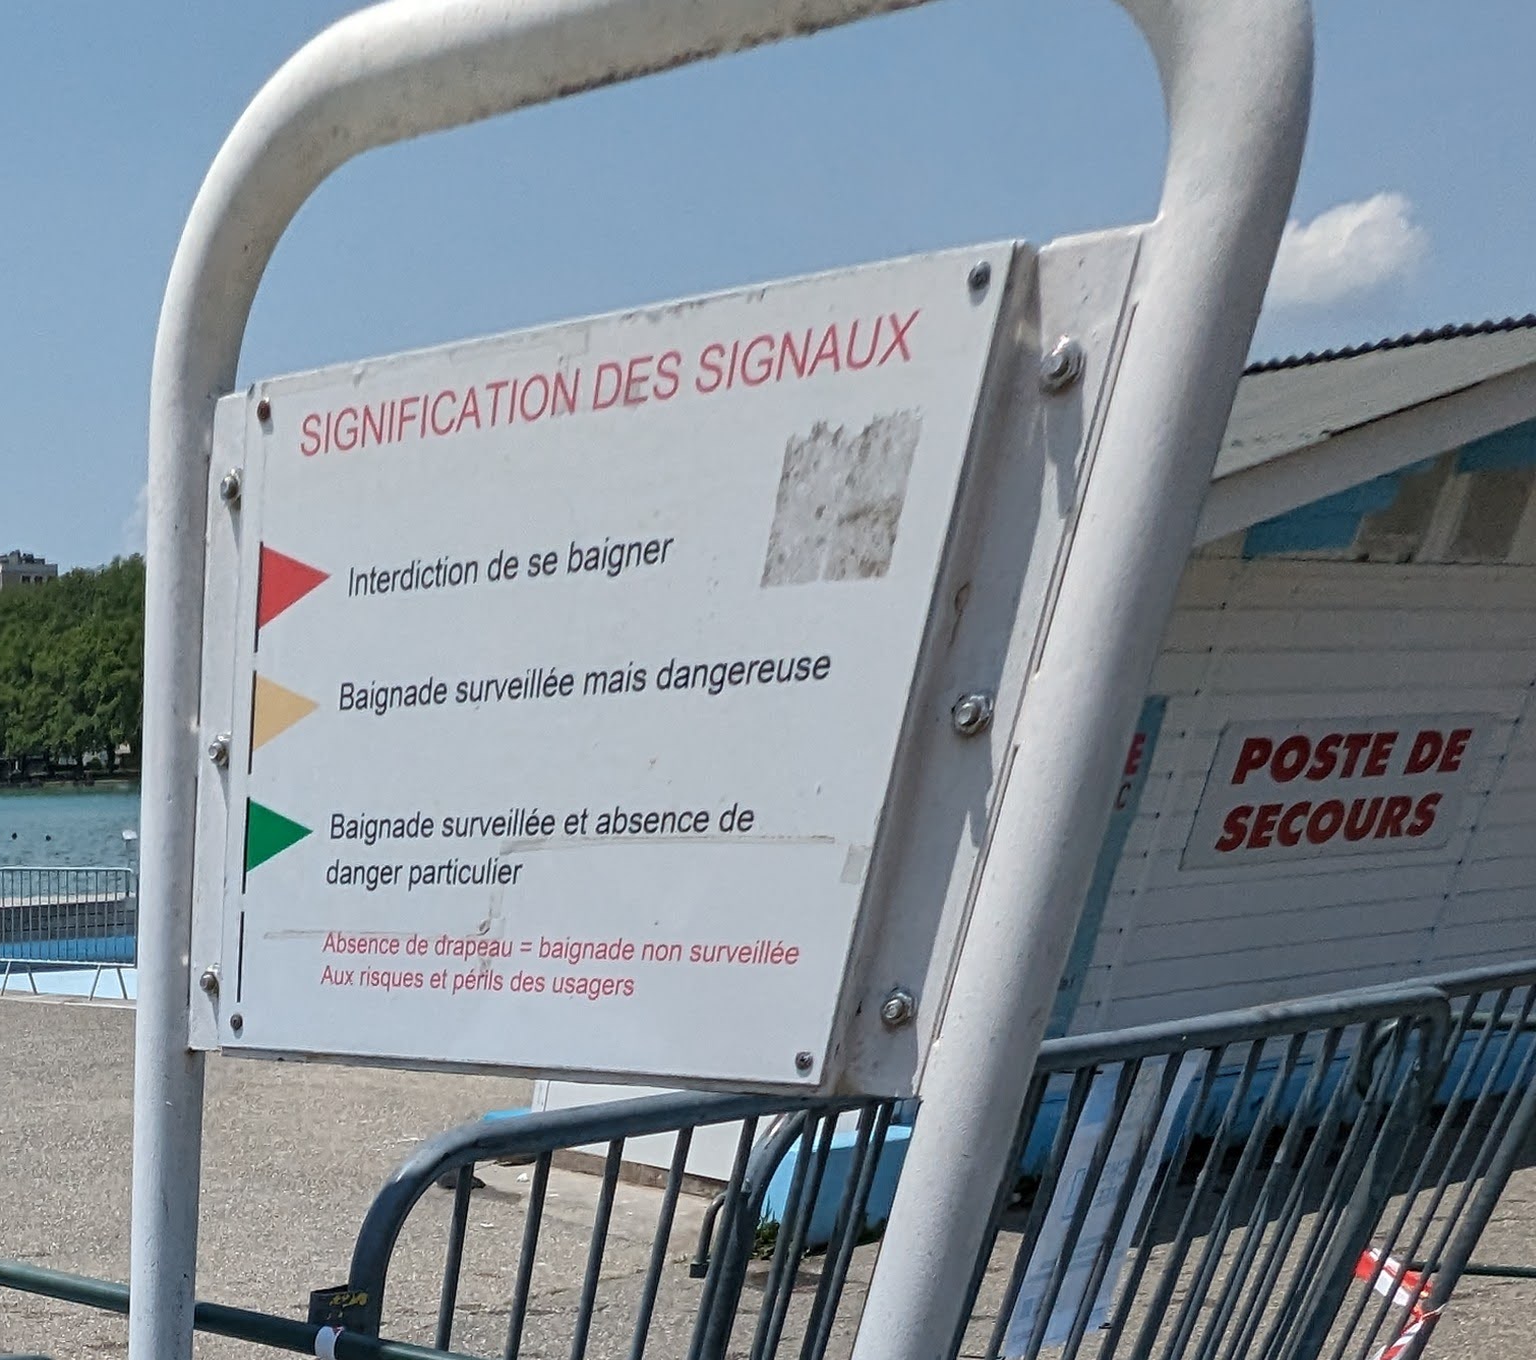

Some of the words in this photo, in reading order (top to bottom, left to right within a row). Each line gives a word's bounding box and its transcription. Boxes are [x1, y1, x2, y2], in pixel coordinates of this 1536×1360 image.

[301, 367, 582, 457] SIGNIFICATION
[593, 350, 681, 411] DES
[696, 309, 924, 395] SIGNAUX
[348, 555, 478, 598] Interdiction
[487, 547, 519, 581] de
[527, 551, 558, 577] se
[567, 536, 674, 578] baigner
[339, 677, 447, 715] Baignade
[455, 668, 573, 704] surveillée
[583, 662, 647, 696] mais
[656, 654, 831, 697] dangereuse
[1231, 731, 1399, 785] POSTE
[1403, 728, 1473, 775] DE
[330, 812, 434, 845] Baignade
[441, 807, 555, 839] surveillée
[564, 810, 588, 836] et
[595, 805, 709, 835] absence
[718, 803, 755, 833] de
[1214, 793, 1443, 852] SECOURS
[326, 861, 402, 890] danger
[408, 858, 522, 890] particulier
[322, 933, 399, 955] Absence
[405, 934, 428, 955] de
[434, 934, 513, 961] drapeau
[520, 941, 533, 952] =
[538, 937, 634, 966] baignade
[641, 941, 682, 962] non
[689, 940, 799, 966] surveillée
[320, 966, 353, 986] Aux
[359, 967, 423, 993] risques
[430, 970, 447, 989] et
[452, 969, 503, 994] périls
[510, 970, 545, 993] des
[552, 976, 634, 999] usagers
